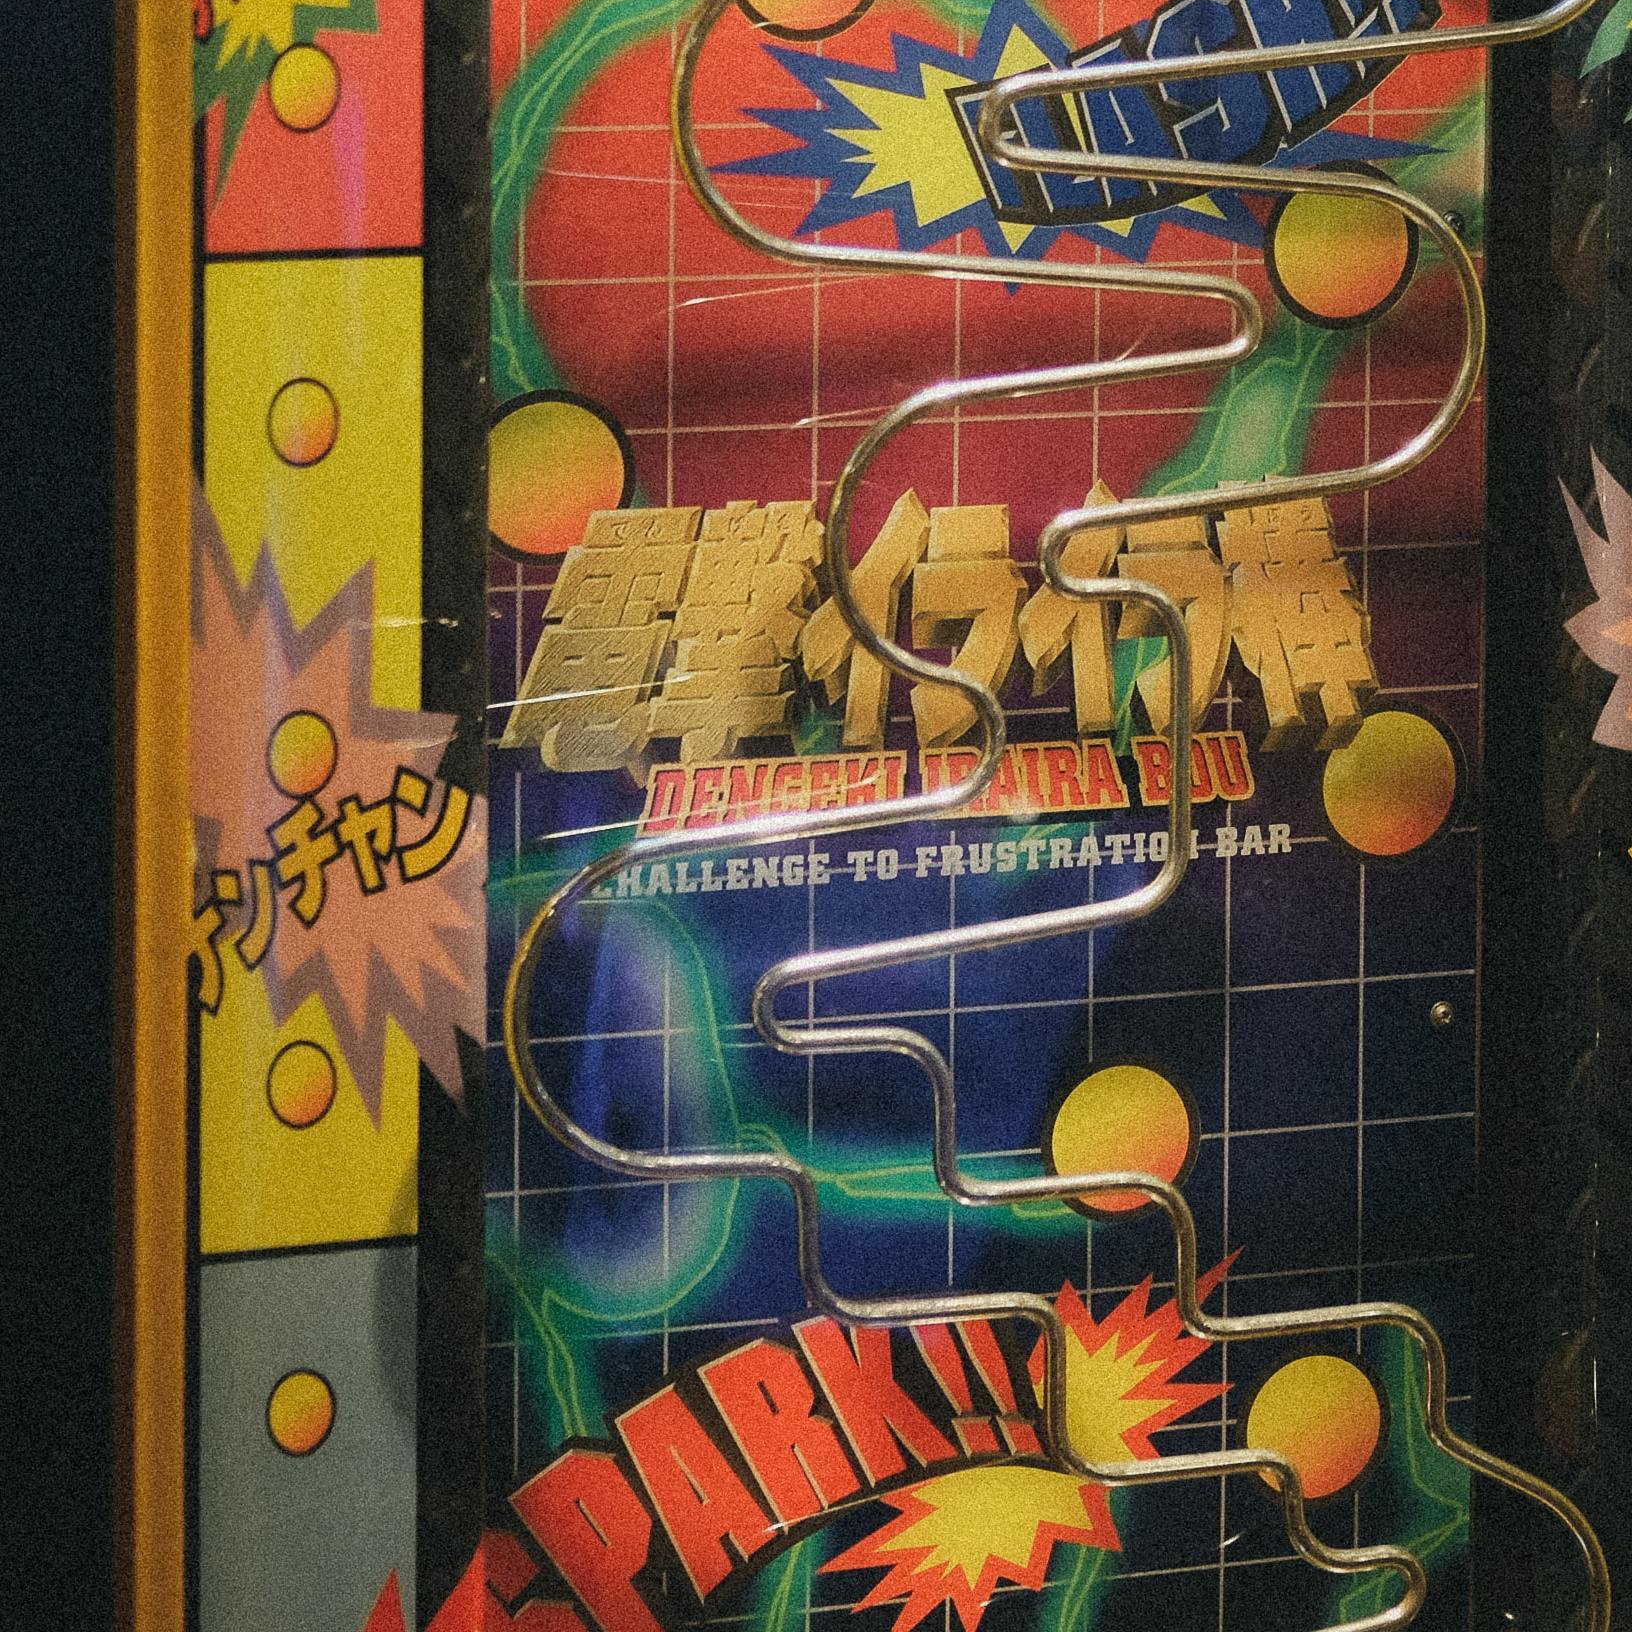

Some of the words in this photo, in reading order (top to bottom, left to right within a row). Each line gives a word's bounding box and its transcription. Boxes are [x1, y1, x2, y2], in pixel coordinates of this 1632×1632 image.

[640, 750, 908, 834] DENGEKI
[847, 847, 900, 881] TO
[1215, 822, 1293, 859] BAR
